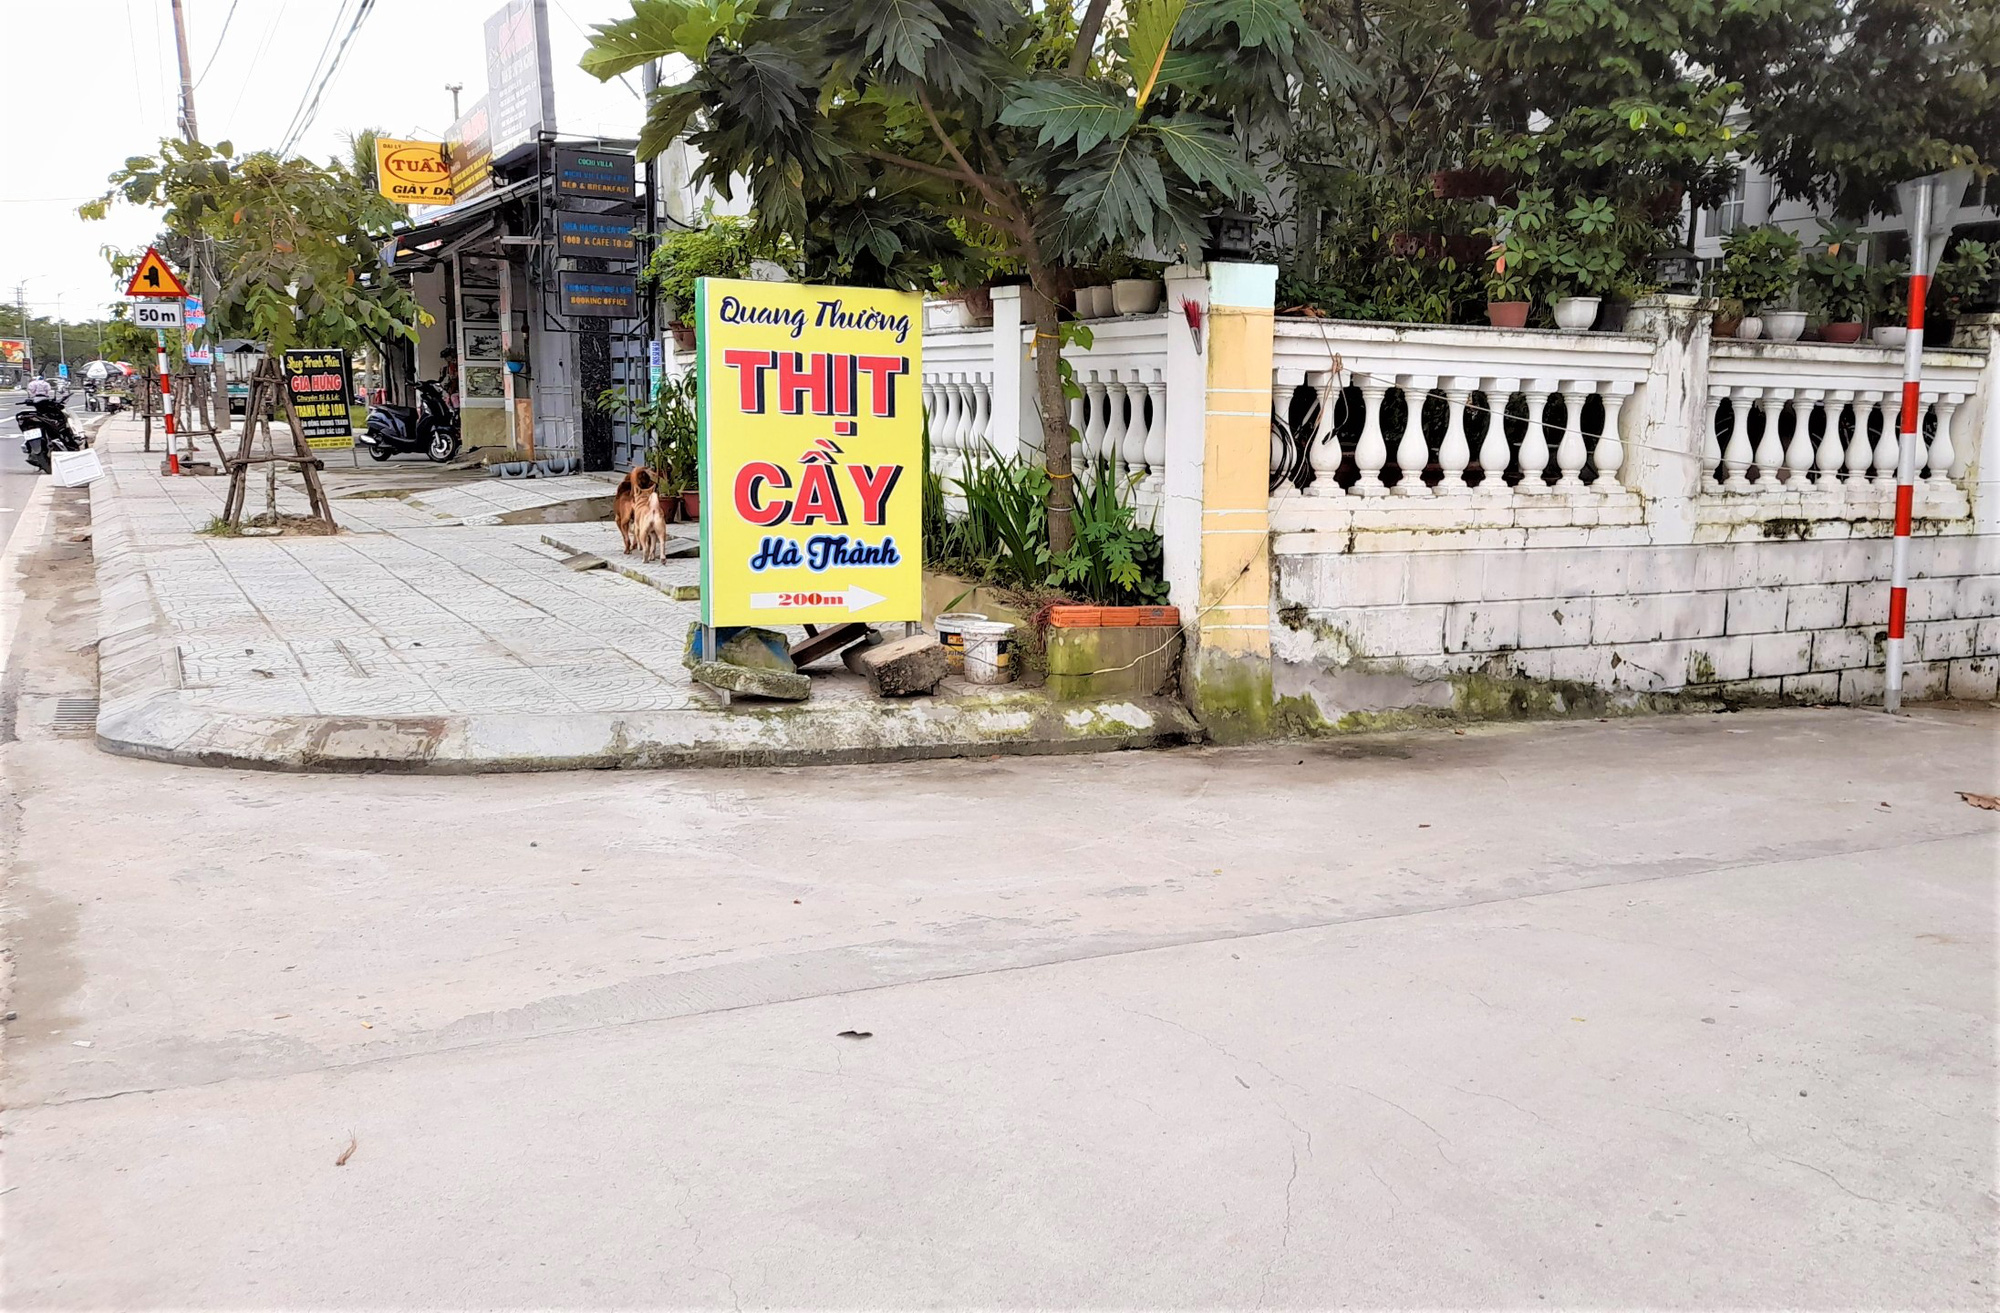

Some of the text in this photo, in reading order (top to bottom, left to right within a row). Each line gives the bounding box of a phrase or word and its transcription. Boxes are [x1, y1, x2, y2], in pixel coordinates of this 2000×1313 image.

[391, 157, 449, 173] TUẤN
[597, 159, 614, 168] VILLA
[433, 186, 453, 196] DA
[580, 182, 586, 190] &
[587, 183, 630, 193] BREAKFAST
[562, 235, 581, 244] FOOD
[584, 237, 590, 245] &
[612, 239, 622, 247] TO
[570, 296, 602, 305] BOOKING
[139, 308, 159, 322] 50
[720, 296, 913, 343] Quang Thường
[291, 375, 311, 392] GIA
[723, 349, 909, 436] THỊT
[294, 405, 316, 417] TRANH
[734, 439, 904, 526] CẦY
[751, 536, 899, 572] Hà Thành
[778, 593, 844, 606] 200m
